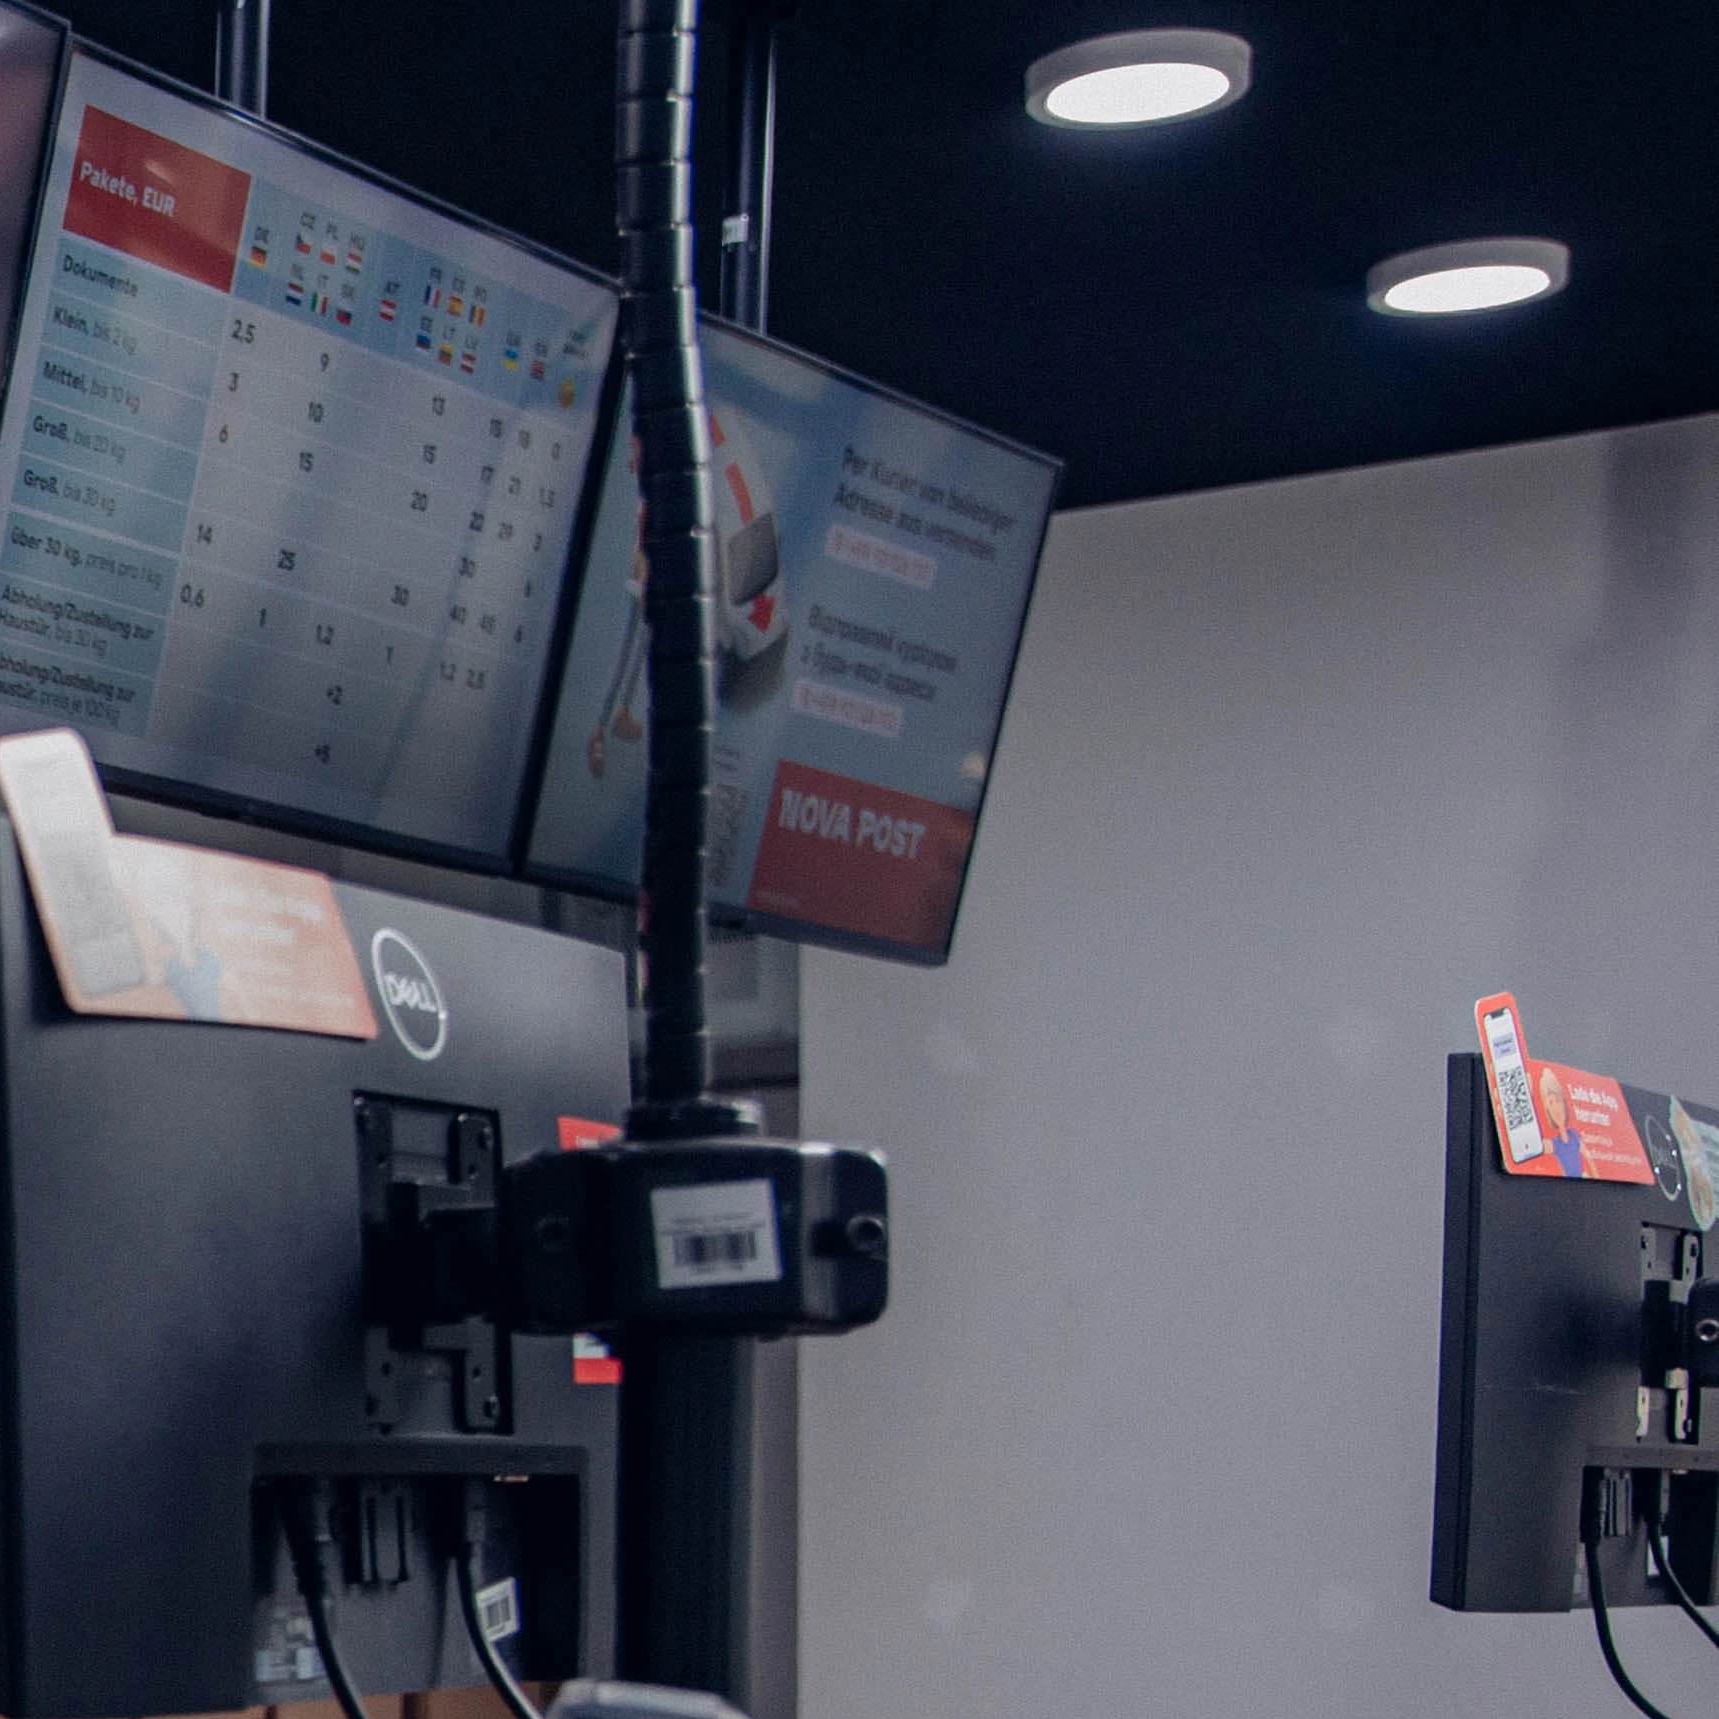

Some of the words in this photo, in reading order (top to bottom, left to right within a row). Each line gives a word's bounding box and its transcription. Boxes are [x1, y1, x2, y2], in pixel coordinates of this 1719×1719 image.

[79, 160, 138, 206] Pakete,
[142, 186, 176, 217] EUR
[63, 254, 139, 298] Dokumente
[53, 305, 88, 336] Klein,
[92, 322, 111, 342] bis
[231, 318, 256, 344] 2,5
[319, 352, 330, 372] 9
[42, 361, 87, 395] Mittel,
[90, 375, 109, 397] bis
[125, 392, 141, 415] kg
[229, 372, 239, 393] 3
[308, 402, 324, 423] 10
[32, 414, 70, 444] Groß,
[93, 434, 109, 452] 20
[111, 441, 126, 464] kg
[218, 424, 229, 444] 6
[299, 451, 314, 473] 15
[23, 469, 61, 496] Groß,
[411, 490, 429, 512] 20
[197, 524, 212, 545] 14
[45, 536, 62, 558] 30
[277, 549, 296, 572] 25
[181, 583, 205, 609] 0,6
[392, 584, 410, 607] 30
[133, 623, 154, 642] zur
[777, 787, 851, 844] NOVA
[856, 808, 926, 860] POST
[384, 972, 438, 1013] DELL
